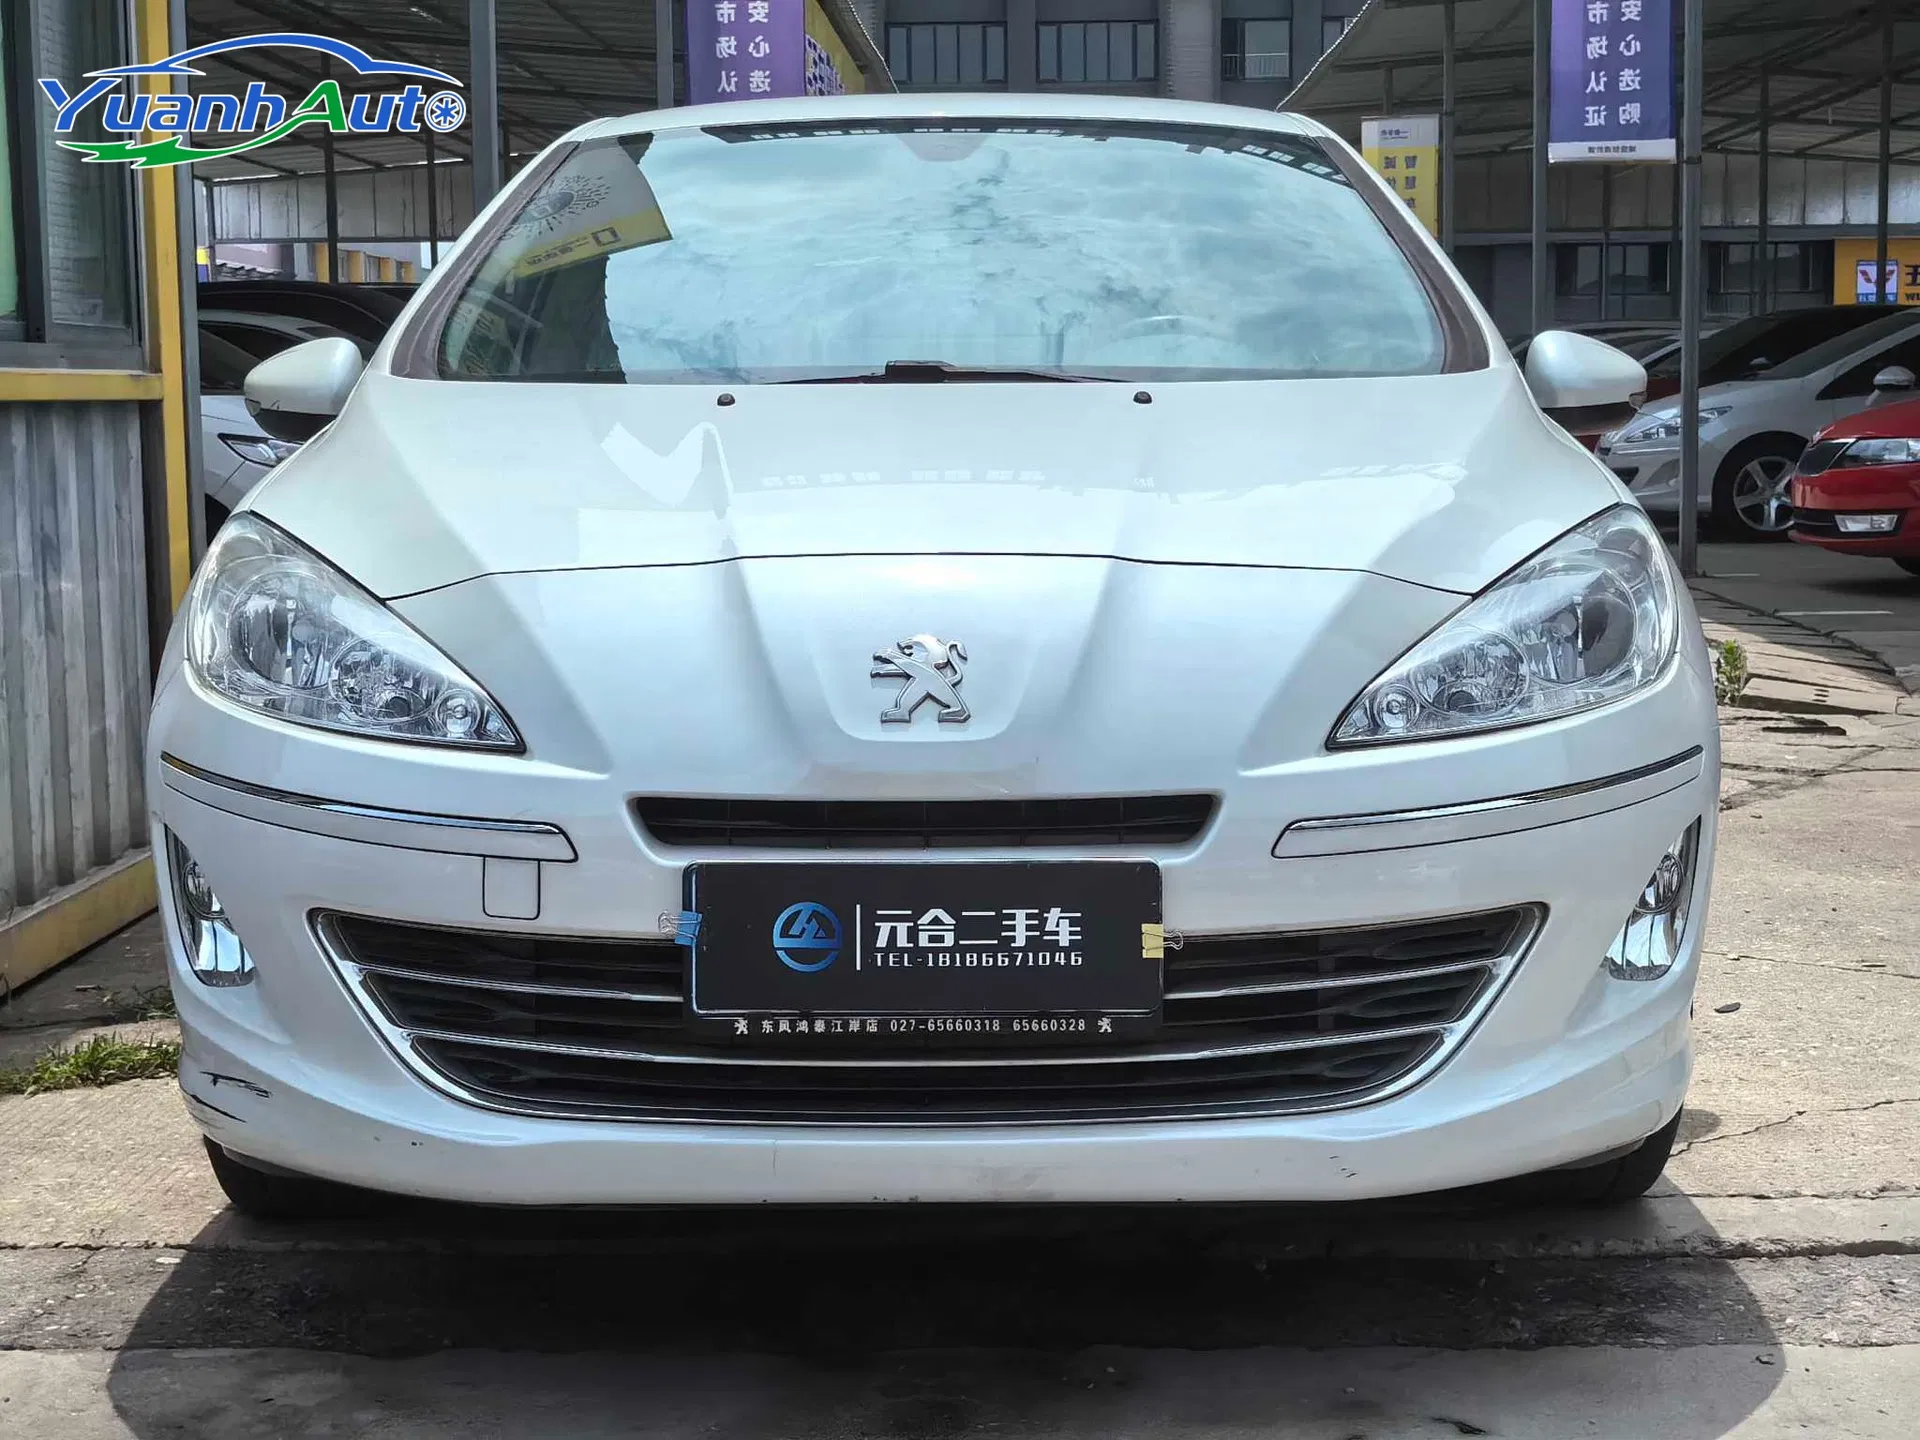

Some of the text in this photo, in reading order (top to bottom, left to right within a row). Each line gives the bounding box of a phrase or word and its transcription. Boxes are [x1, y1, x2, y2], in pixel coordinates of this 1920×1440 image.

[873, 908, 1083, 948] 元合二手车
[874, 952, 1083, 967] TEL-18186671046
[890, 1018, 1000, 1032] 027-65660318
[1012, 1018, 1086, 1032] 65660328
